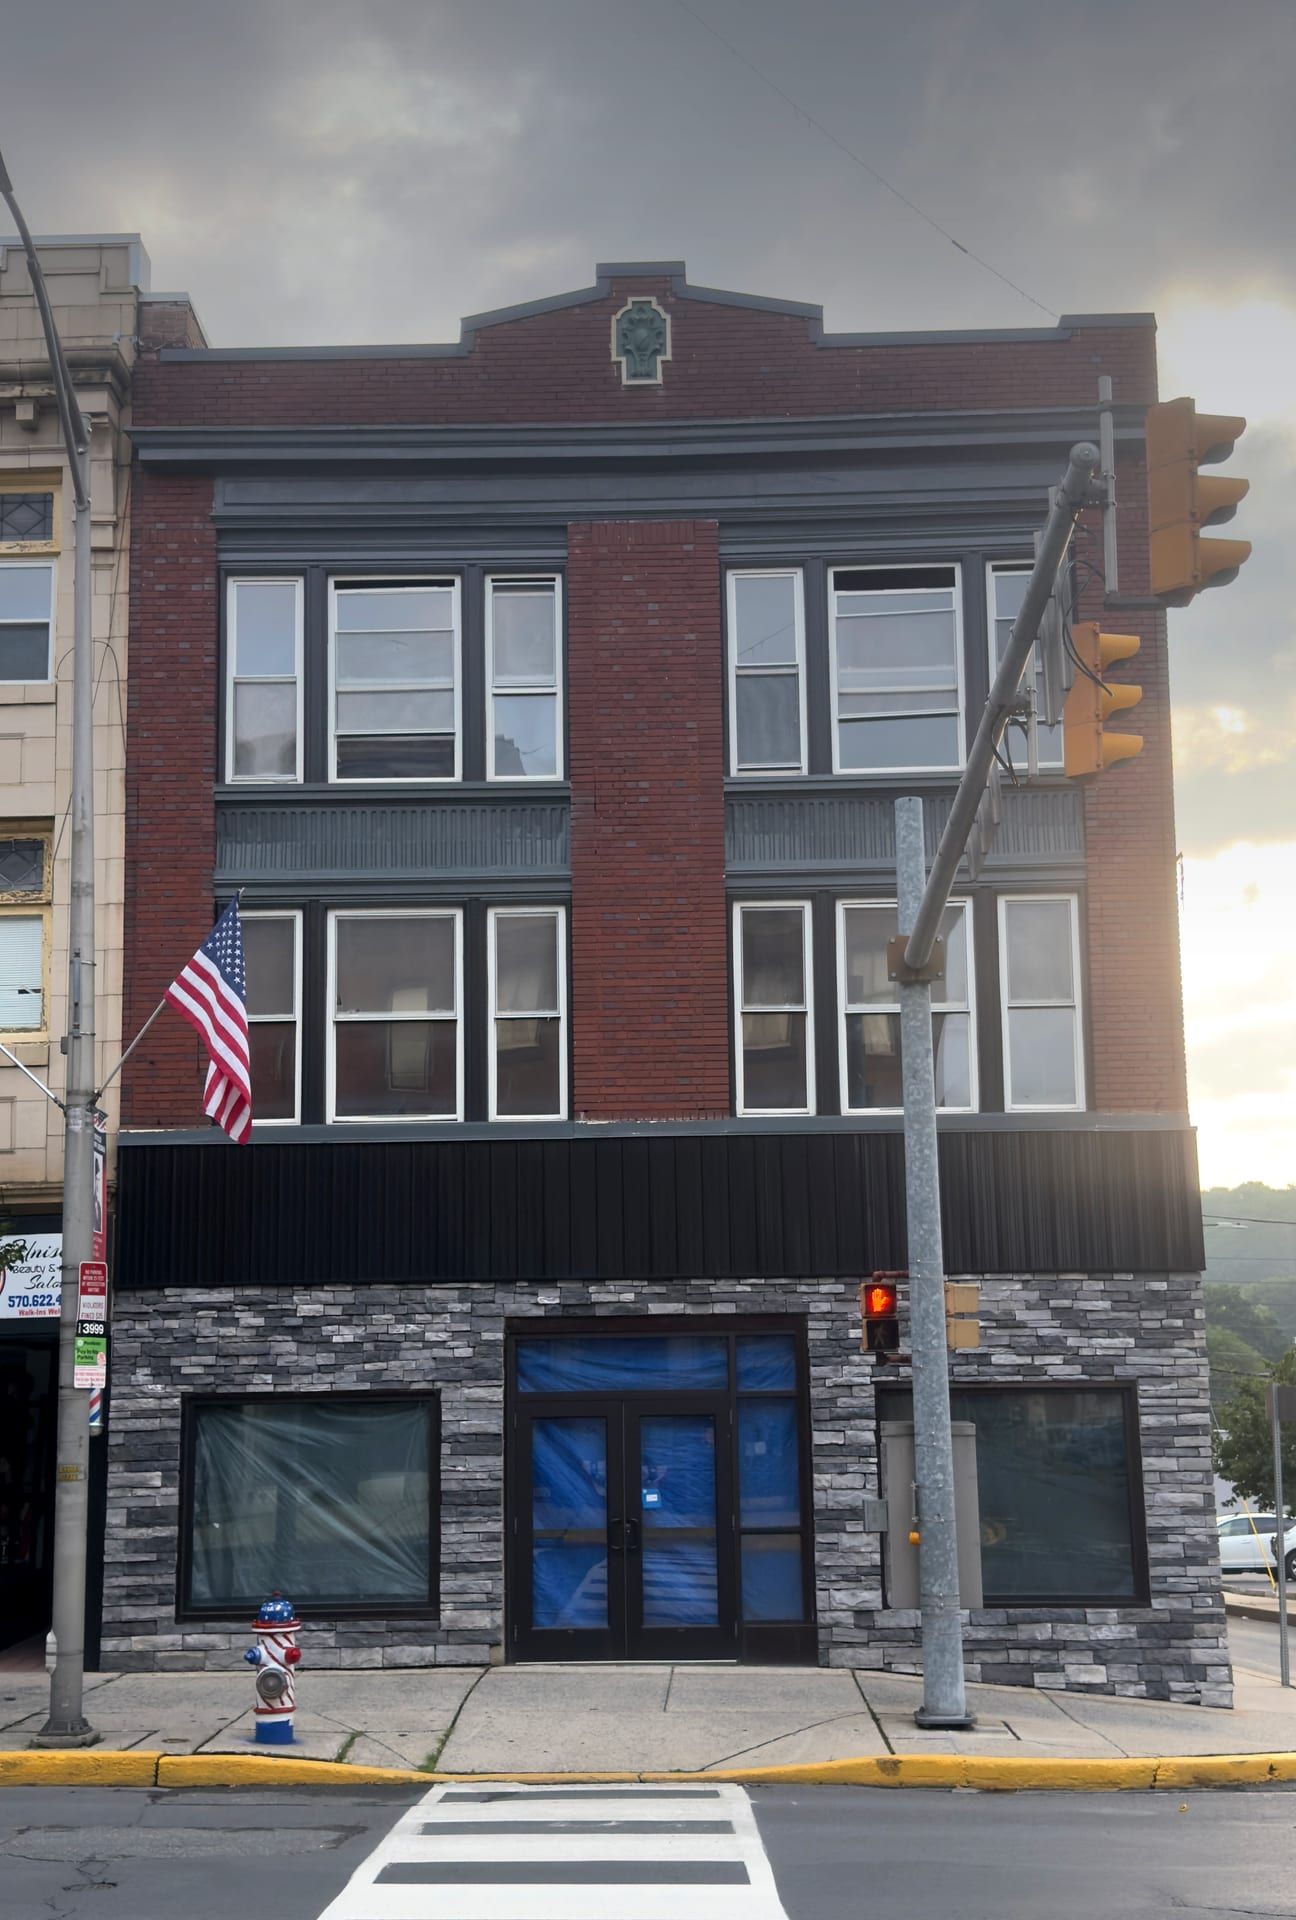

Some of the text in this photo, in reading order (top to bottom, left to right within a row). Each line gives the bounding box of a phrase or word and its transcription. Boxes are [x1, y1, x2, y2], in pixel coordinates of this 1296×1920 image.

[13, 1263, 56, 1274] Beauty &
[24, 1274, 62, 1290] Salo
[8, 1294, 62, 1308] 570.622.4
[82, 1323, 104, 1335] 3999
